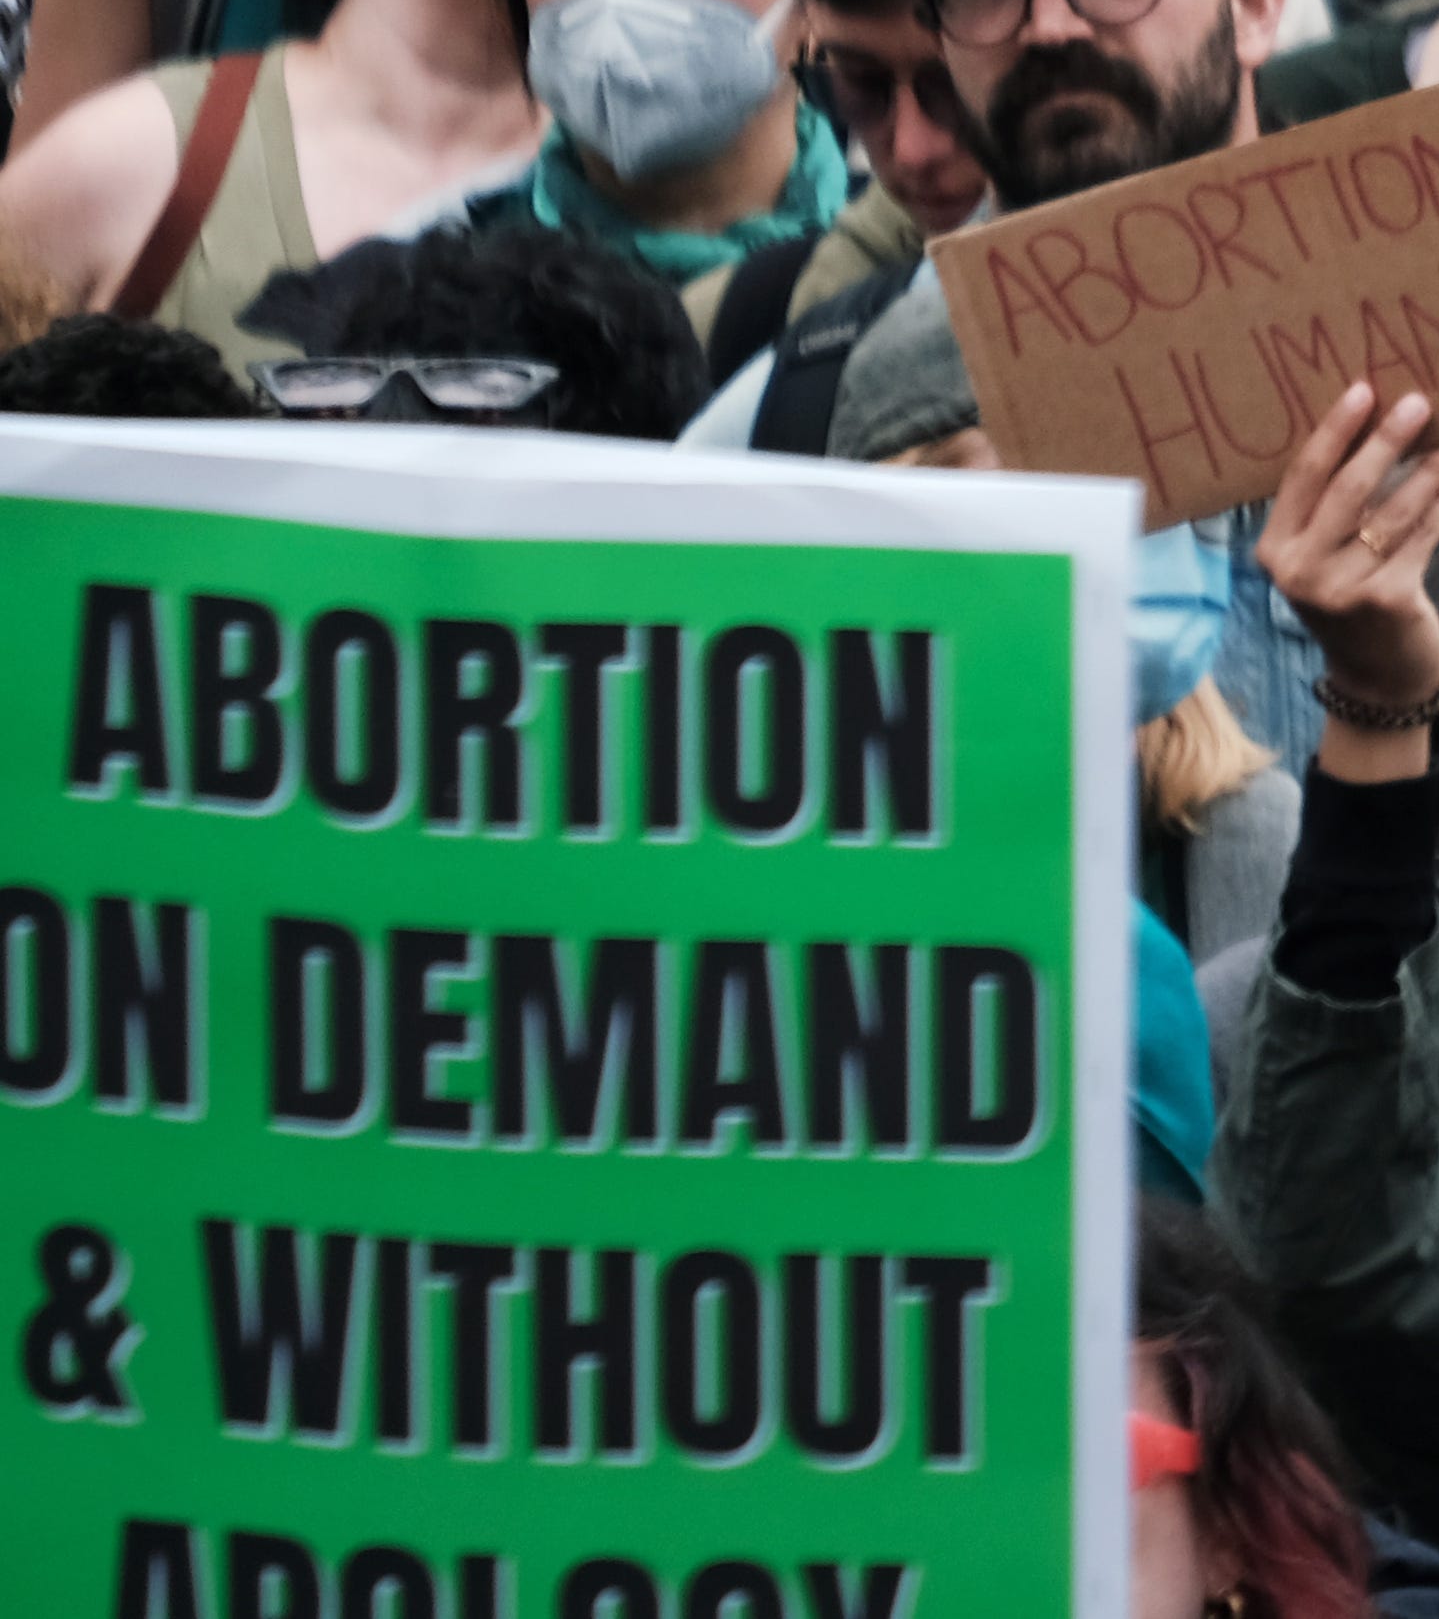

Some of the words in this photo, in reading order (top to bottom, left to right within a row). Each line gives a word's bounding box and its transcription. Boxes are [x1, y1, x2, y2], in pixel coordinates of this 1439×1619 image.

[66, 581, 945, 847] ABORTION
[0, 883, 205, 1122] ON
[264, 914, 1058, 1164] DEMAND
[21, 1219, 143, 1422] &
[197, 1213, 1005, 1473] WITHOUT
